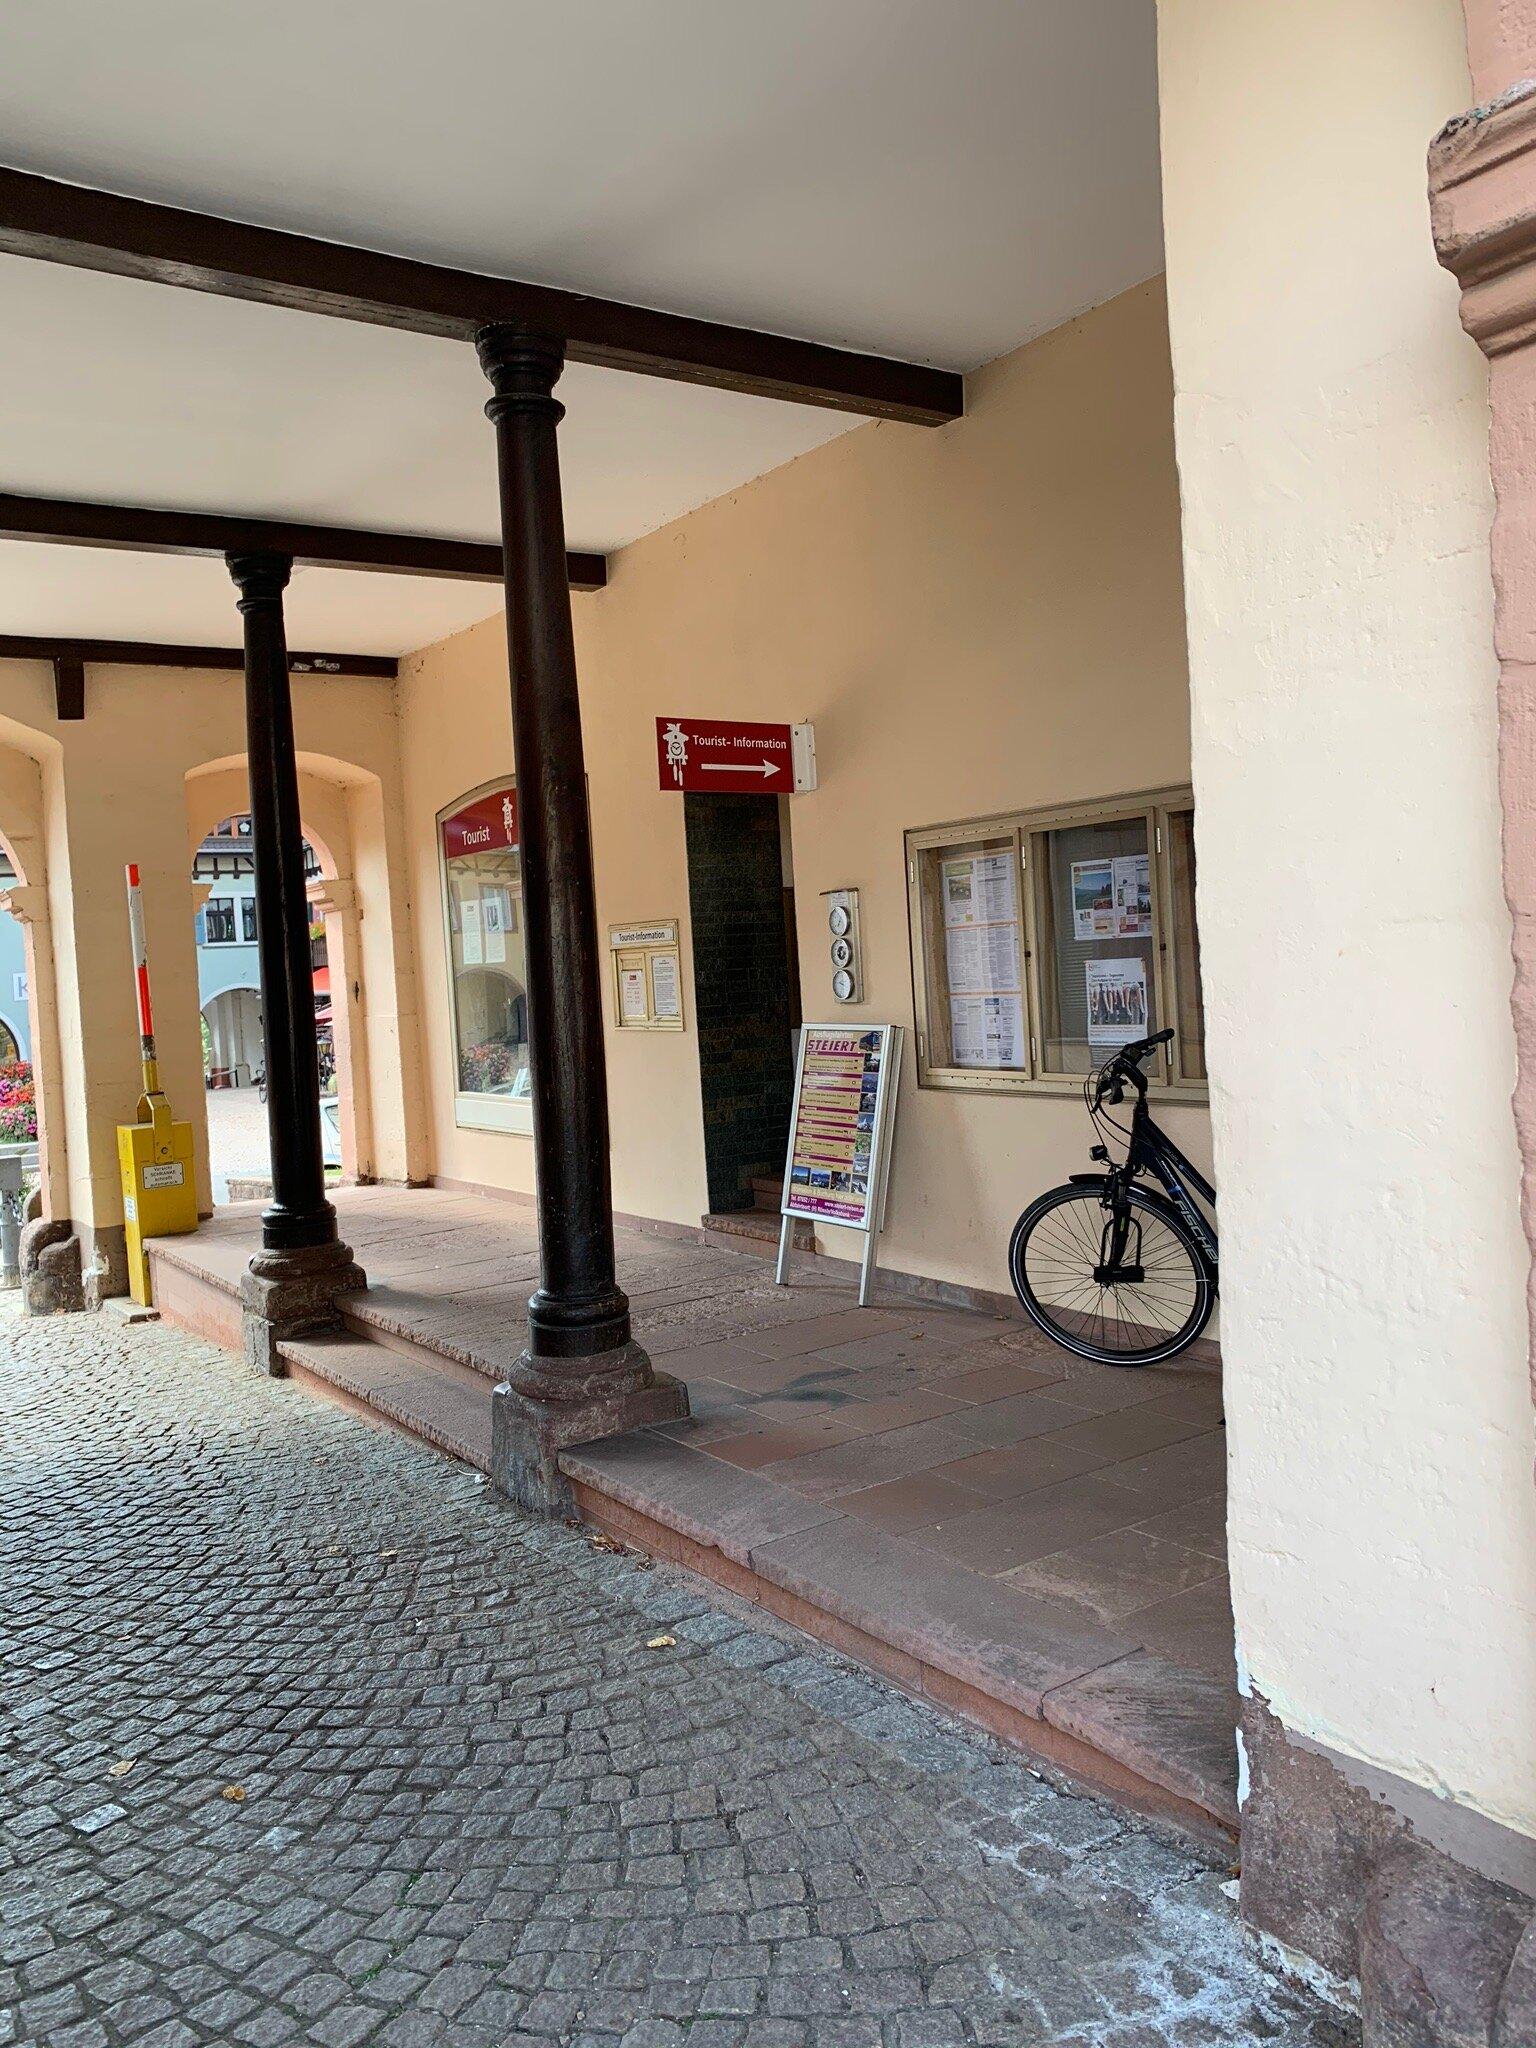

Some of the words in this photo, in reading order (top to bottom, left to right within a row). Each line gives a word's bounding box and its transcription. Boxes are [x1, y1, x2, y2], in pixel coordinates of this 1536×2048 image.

[693, 735, 731, 747] Tourist-
[734, 737, 787, 749] Information
[461, 826, 490, 846] Tourist
[618, 930, 665, 942] Tourist-Information
[808, 1040, 857, 1051] STEIERT
